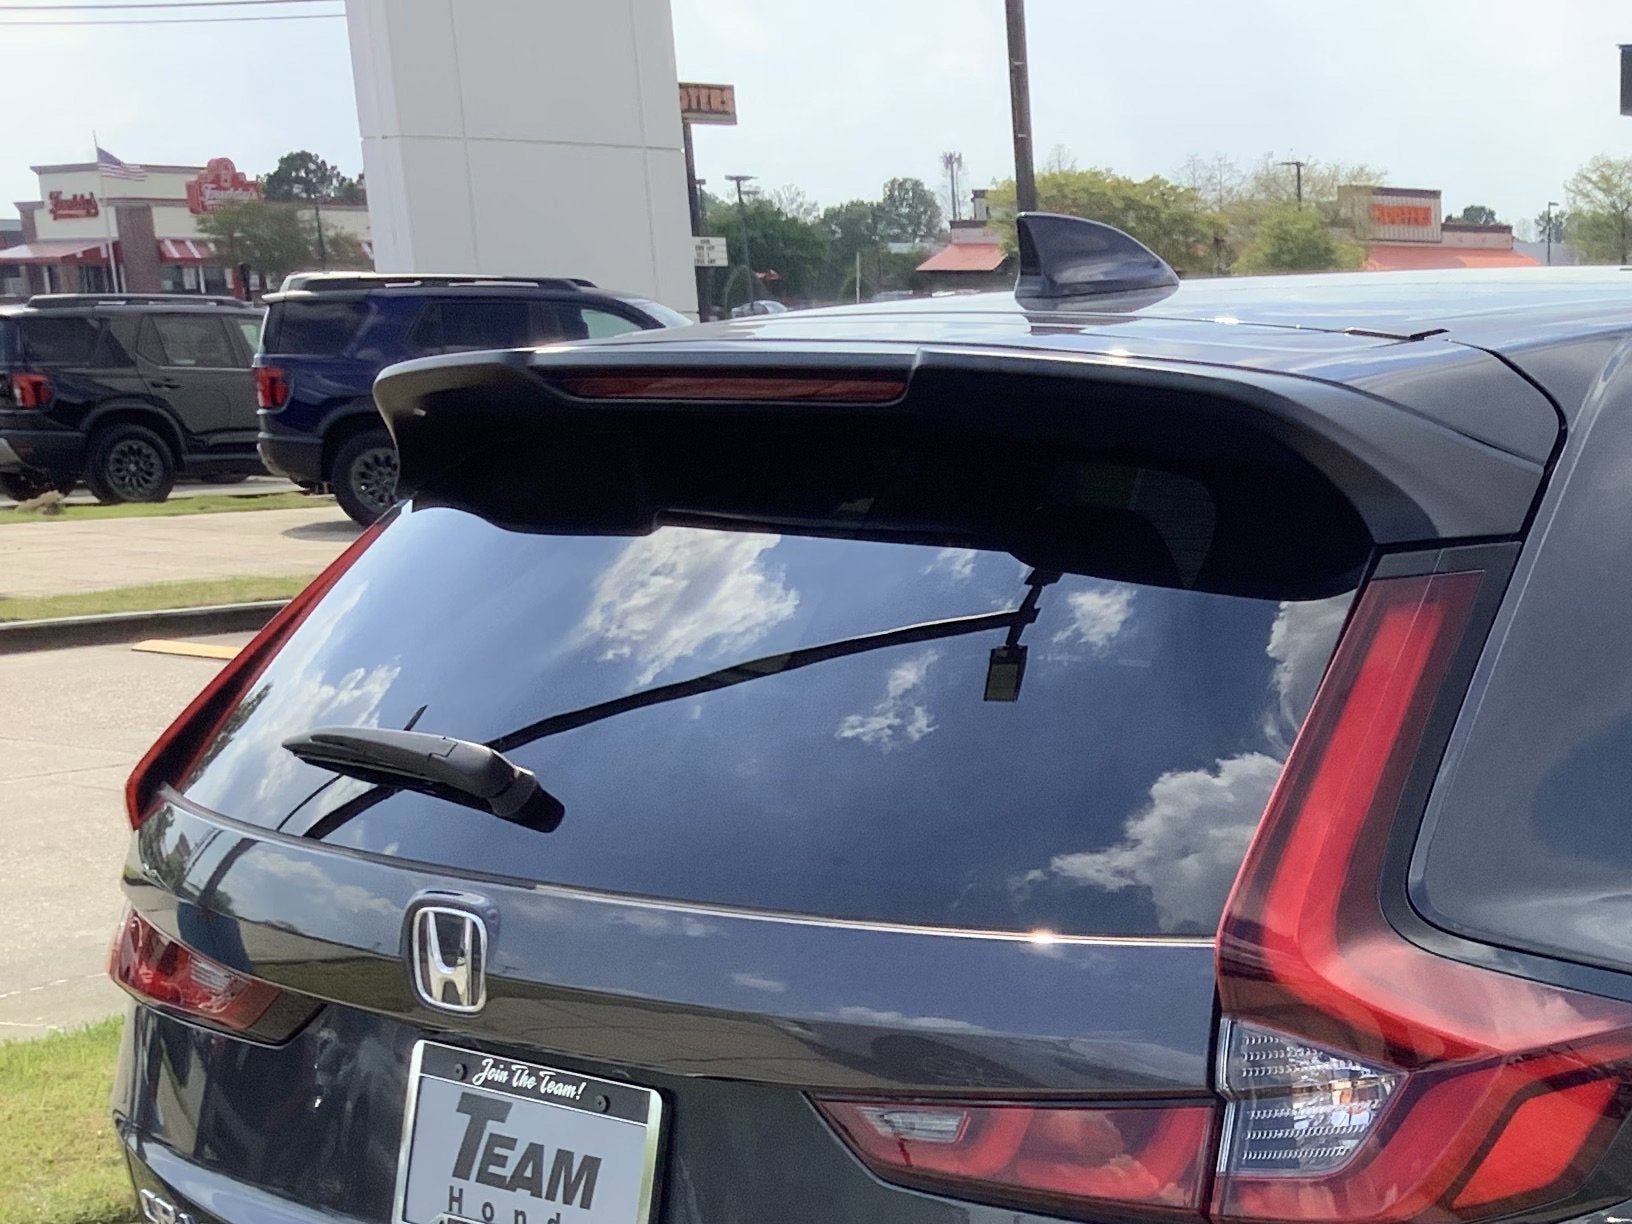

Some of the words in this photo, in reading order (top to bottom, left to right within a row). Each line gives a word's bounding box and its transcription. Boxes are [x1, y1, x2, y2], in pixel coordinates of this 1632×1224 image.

[472, 1058, 509, 1086] Join
[511, 1064, 537, 1090] The
[539, 1070, 587, 1100] Team!
[452, 1092, 603, 1210] TEAM
